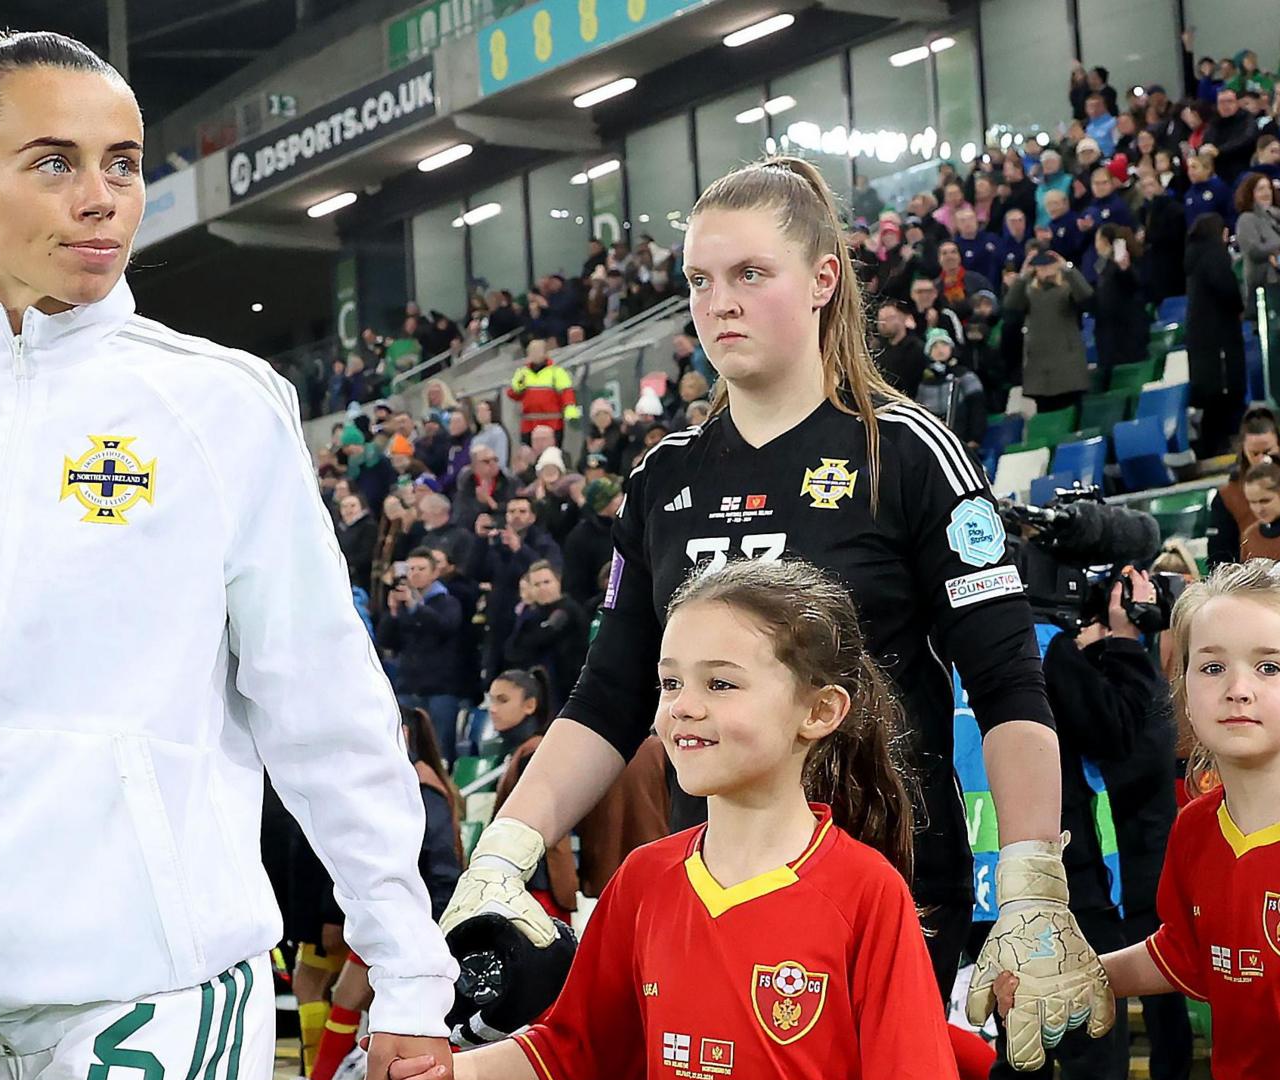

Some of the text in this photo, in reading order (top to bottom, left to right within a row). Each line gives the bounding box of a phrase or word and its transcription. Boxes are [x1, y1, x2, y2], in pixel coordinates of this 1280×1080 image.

[253, 71, 434, 182] JDSPORTS.CO.UK
[111, 474, 141, 483] IRELAND
[971, 534, 993, 545] Strong
[948, 579, 966, 588] UEFA
[949, 574, 1019, 598] FOUNDATION
[1268, 900, 1277, 911] FS
[759, 975, 821, 993] FS CG
